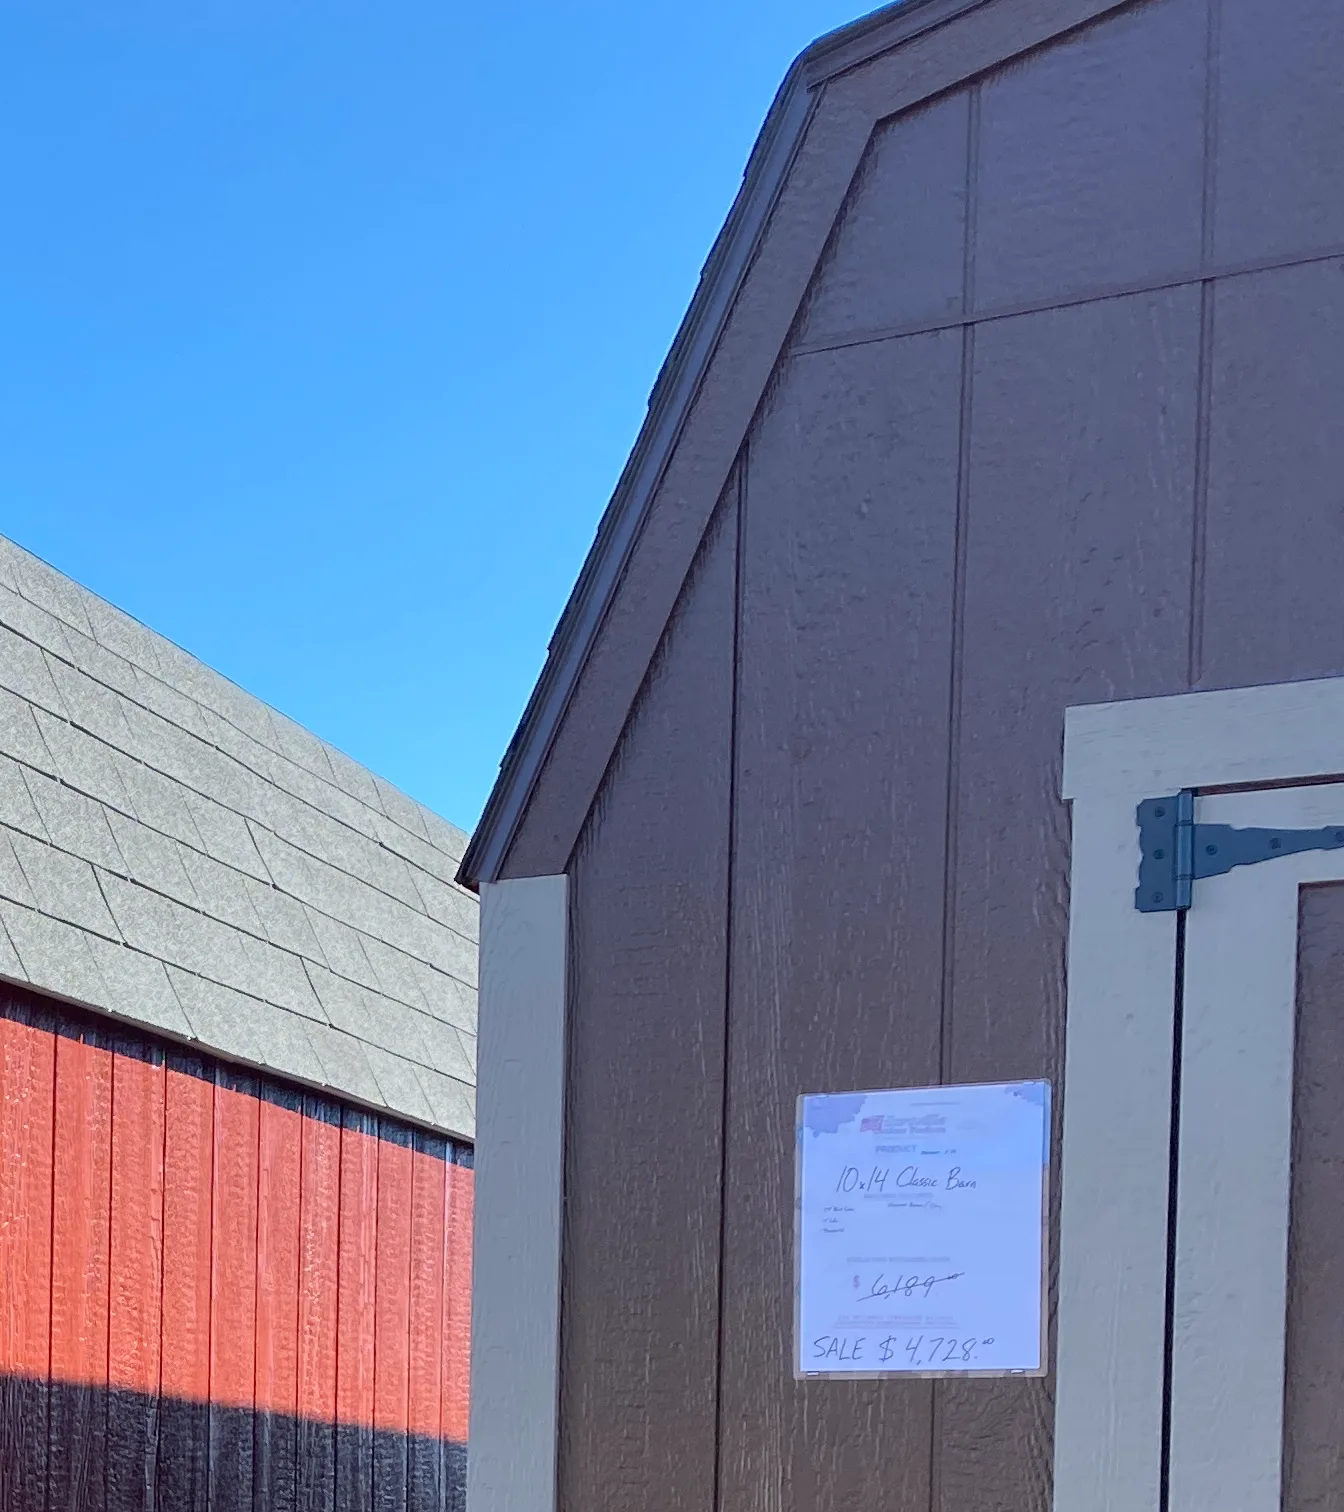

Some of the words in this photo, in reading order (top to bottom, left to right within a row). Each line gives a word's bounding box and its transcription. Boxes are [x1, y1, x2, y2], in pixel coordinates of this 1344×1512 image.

[835, 1165, 890, 1192] 10x14
[896, 1165, 938, 1188] Classic
[945, 1166, 977, 1190] Barn
[813, 1335, 867, 1361] SALE
